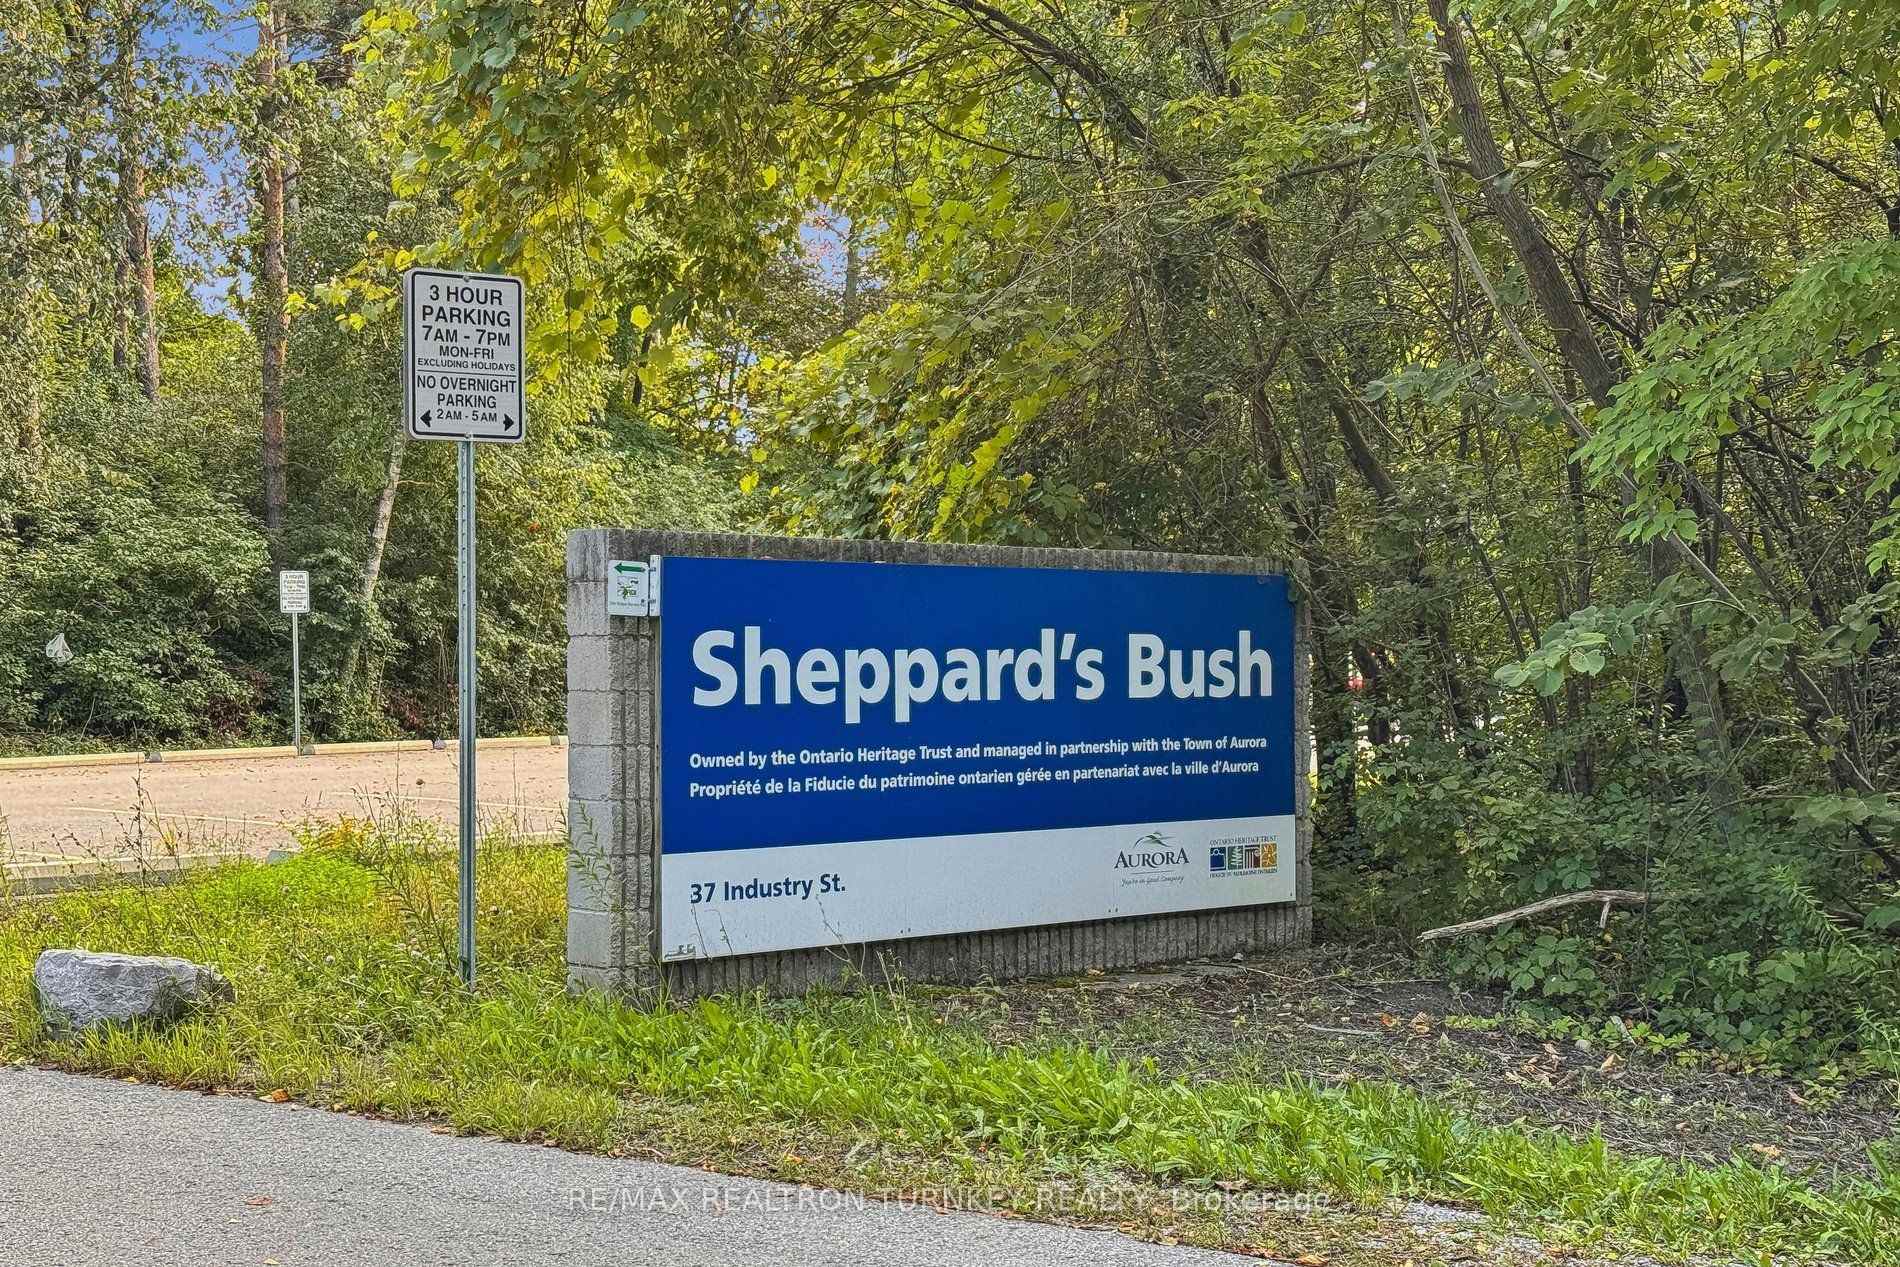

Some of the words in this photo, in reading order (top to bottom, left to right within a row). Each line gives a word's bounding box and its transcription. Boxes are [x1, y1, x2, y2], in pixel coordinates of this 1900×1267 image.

[430, 284, 439, 301] 3
[446, 286, 503, 305] HOUR
[422, 305, 511, 327] PARKING
[422, 325, 458, 343] 7AM
[476, 329, 510, 346] 7PM
[439, 345, 494, 360] MON-FRI
[417, 358, 469, 369] EXCLUDING
[471, 360, 516, 372] HOLIDAYS
[417, 375, 436, 389] NO
[440, 376, 517, 393] OVERNIGHT
[437, 393, 497, 409] PARKING
[692, 625, 1105, 724] Sheppard's
[1128, 630, 1272, 699] Bush
[690, 751, 744, 768] Owned
[749, 751, 766, 769] by
[771, 750, 796, 765] the
[799, 748, 854, 764] Ontario
[857, 747, 916, 764] Heritage
[919, 745, 952, 760] Trust
[955, 744, 980, 758] and
[983, 742, 1042, 760] managed
[1045, 741, 1057, 755] in
[1060, 739, 1129, 758] partnership
[1132, 737, 1159, 752] with
[1161, 737, 1181, 751] the
[1183, 737, 1213, 750] Town
[1215, 735, 1228, 749] of
[1230, 736, 1267, 748] Aurora
[690, 778, 761, 799] Propriété
[765, 778, 783, 794] de
[788, 778, 801, 792] la
[805, 775, 855, 792] Fiducie
[859, 774, 877, 789] du
[880, 771, 955, 791] patrimoine
[958, 767, 1014, 785] ontarien
[1016, 767, 1052, 785] gérée
[1055, 769, 1070, 781] en
[1073, 763, 1140, 783] partenariat
[1142, 764, 1169, 777] avec
[1171, 762, 1182, 775] la
[1185, 761, 1209, 775] ville
[1211, 760, 1259, 774] d'Aurora
[1113, 847, 1191, 869] AURORA
[690, 882, 716, 904] 37
[724, 877, 813, 900] Industry
[820, 873, 846, 894] St.
